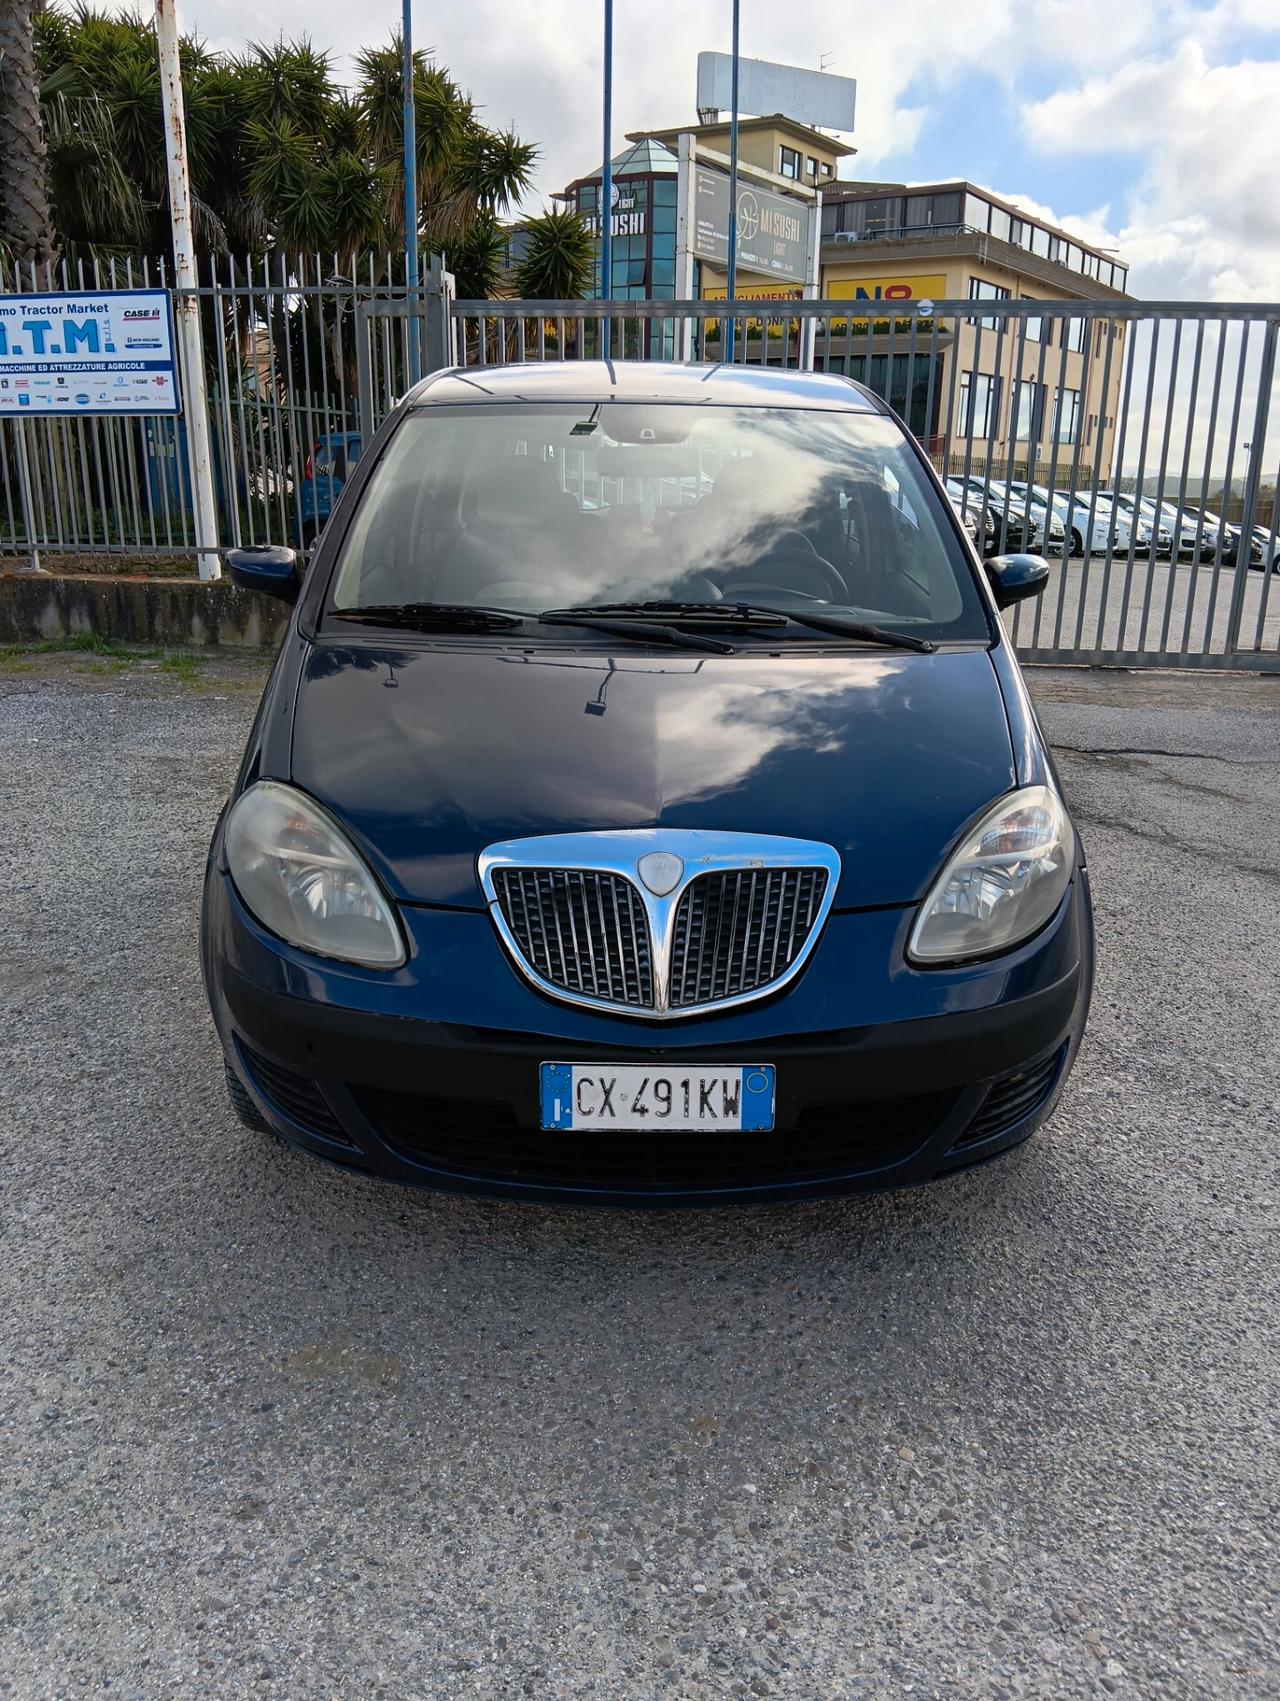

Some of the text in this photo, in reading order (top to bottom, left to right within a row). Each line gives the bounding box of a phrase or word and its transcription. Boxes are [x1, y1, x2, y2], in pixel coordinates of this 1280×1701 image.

[600, 212, 645, 237] USHI
[760, 207, 800, 242] MI SUSHI
[20, 304, 63, 316] Tractor
[66, 302, 109, 314] Market
[0, 362, 146, 373] MACCHINE ED ATTREZZATURE AGRICOLE
[576, 1076, 741, 1119] CX 491KW
